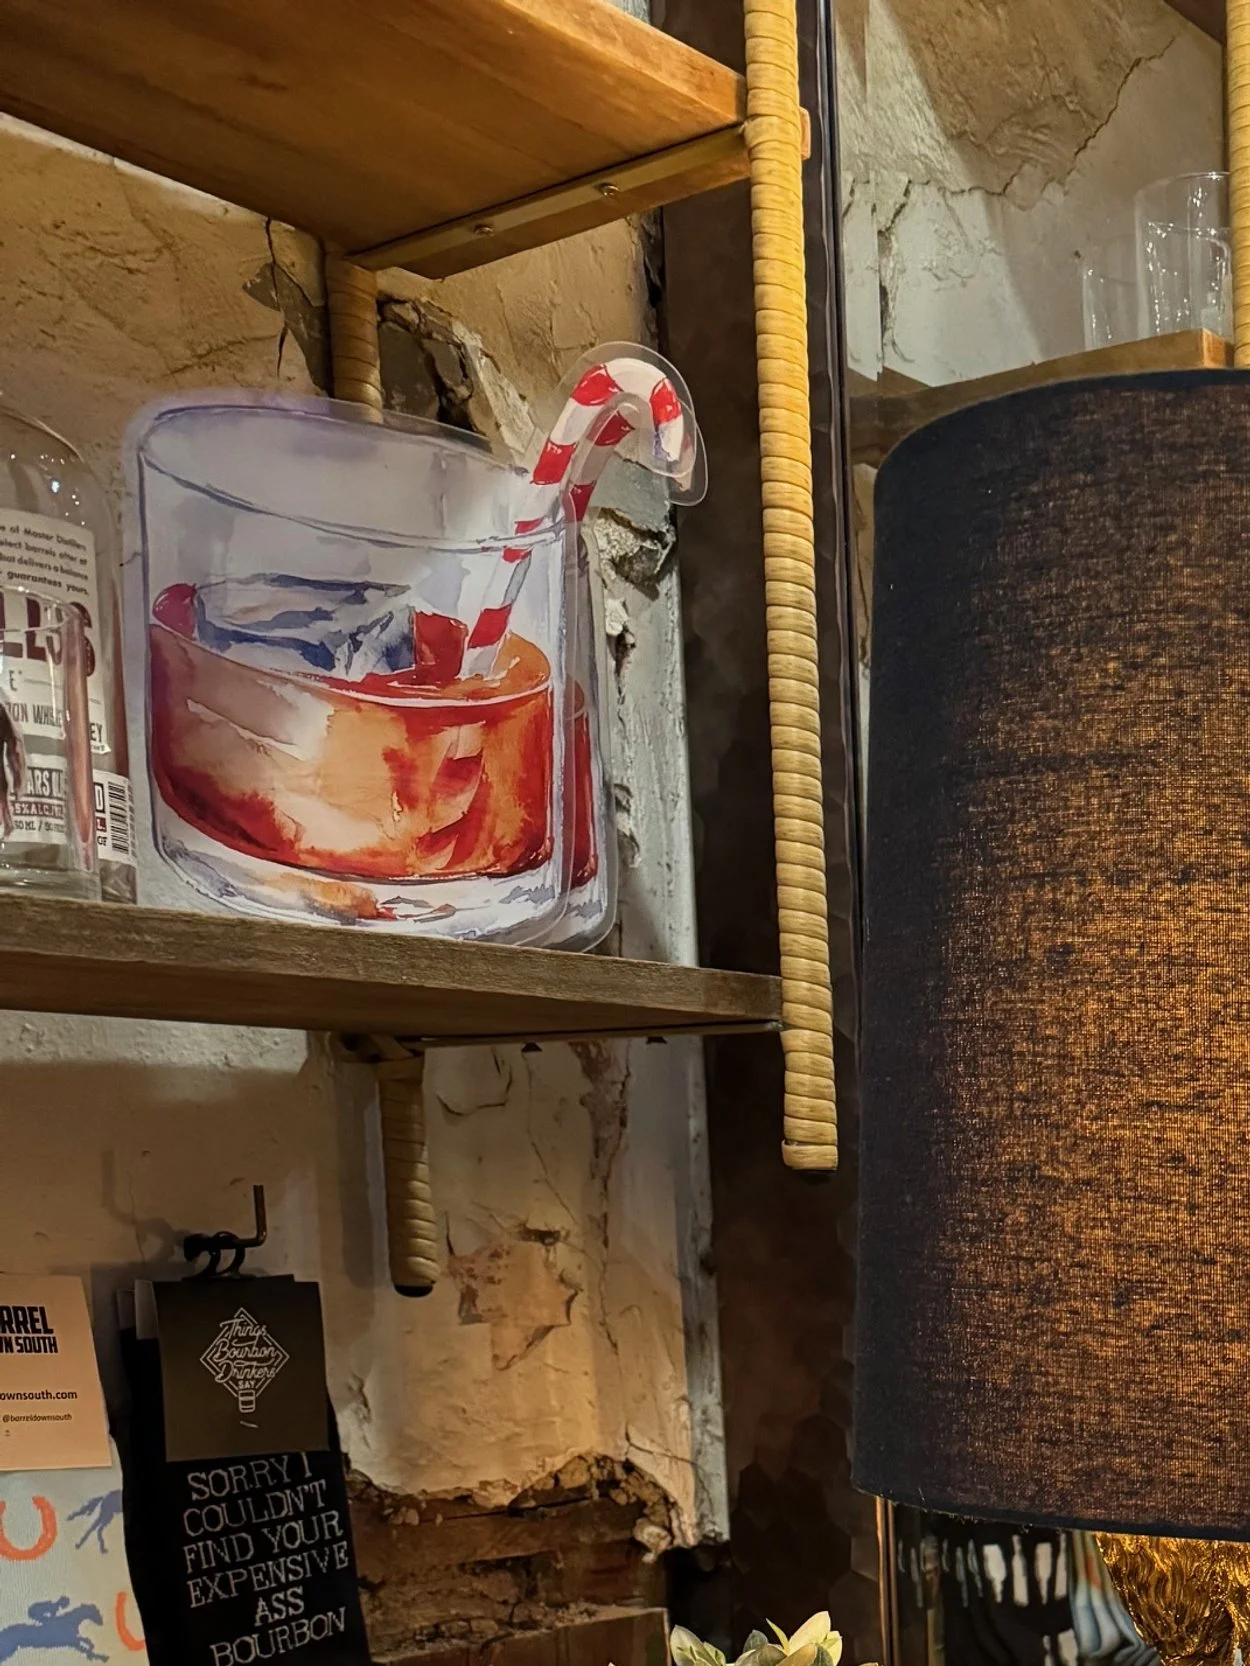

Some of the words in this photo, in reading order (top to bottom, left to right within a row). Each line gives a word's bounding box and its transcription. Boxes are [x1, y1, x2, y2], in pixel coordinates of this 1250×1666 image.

[0, 1306, 54, 1334] RREL
[220, 1319, 267, 1347] Things
[15, 1336, 59, 1353] SOUTH
[213, 1338, 276, 1364] Bourbon
[215, 1360, 276, 1382] Drinkers
[238, 1381, 255, 1389] SAY
[0, 1389, 78, 1400] ownsouth.com
[187, 1454, 290, 1501] SORRY
[302, 1452, 313, 1478] I
[183, 1480, 327, 1538] COULDN'T
[183, 1531, 254, 1575] FIND
[263, 1510, 344, 1554] YOUR
[186, 1542, 350, 1608] EXPENSIVE
[254, 1586, 305, 1627] ASS
